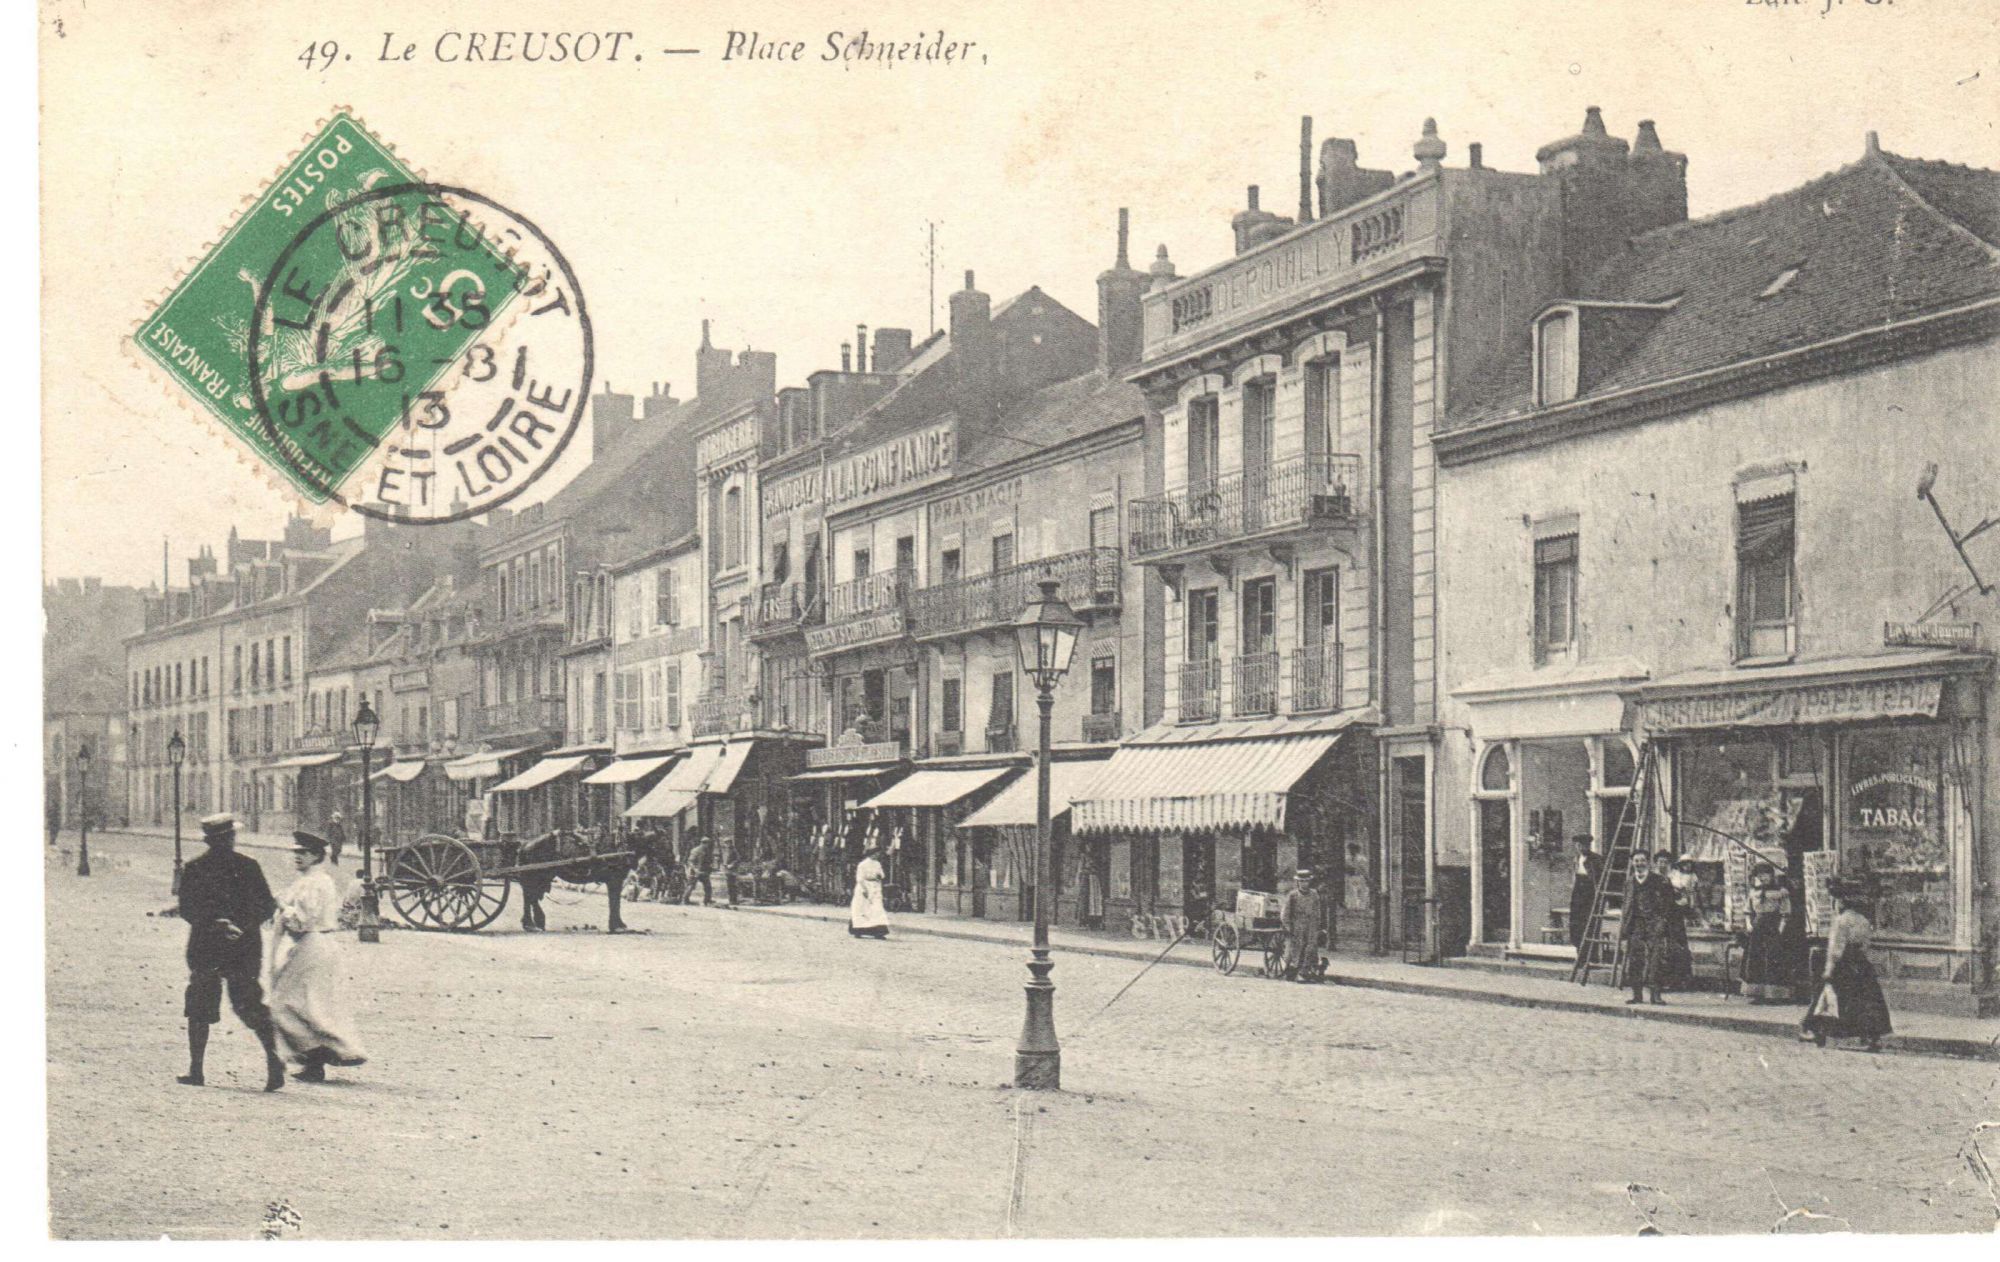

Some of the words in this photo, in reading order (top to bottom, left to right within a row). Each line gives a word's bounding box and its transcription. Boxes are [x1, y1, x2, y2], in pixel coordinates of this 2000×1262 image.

[271, 133, 354, 218] POSTES
[272, 265, 324, 331] LE
[149, 320, 232, 401] FRANÇAISE
[353, 344, 406, 385] 16
[376, 466, 437, 507] ET
[455, 378, 573, 498] LOIRE
[401, 390, 451, 431] 13
[825, 467, 834, 505] A
[838, 458, 858, 502] LA
[859, 430, 951, 496] CONFIANCE
[1931, 622, 1974, 639] Journal
[1861, 807, 1926, 828] TABAC
